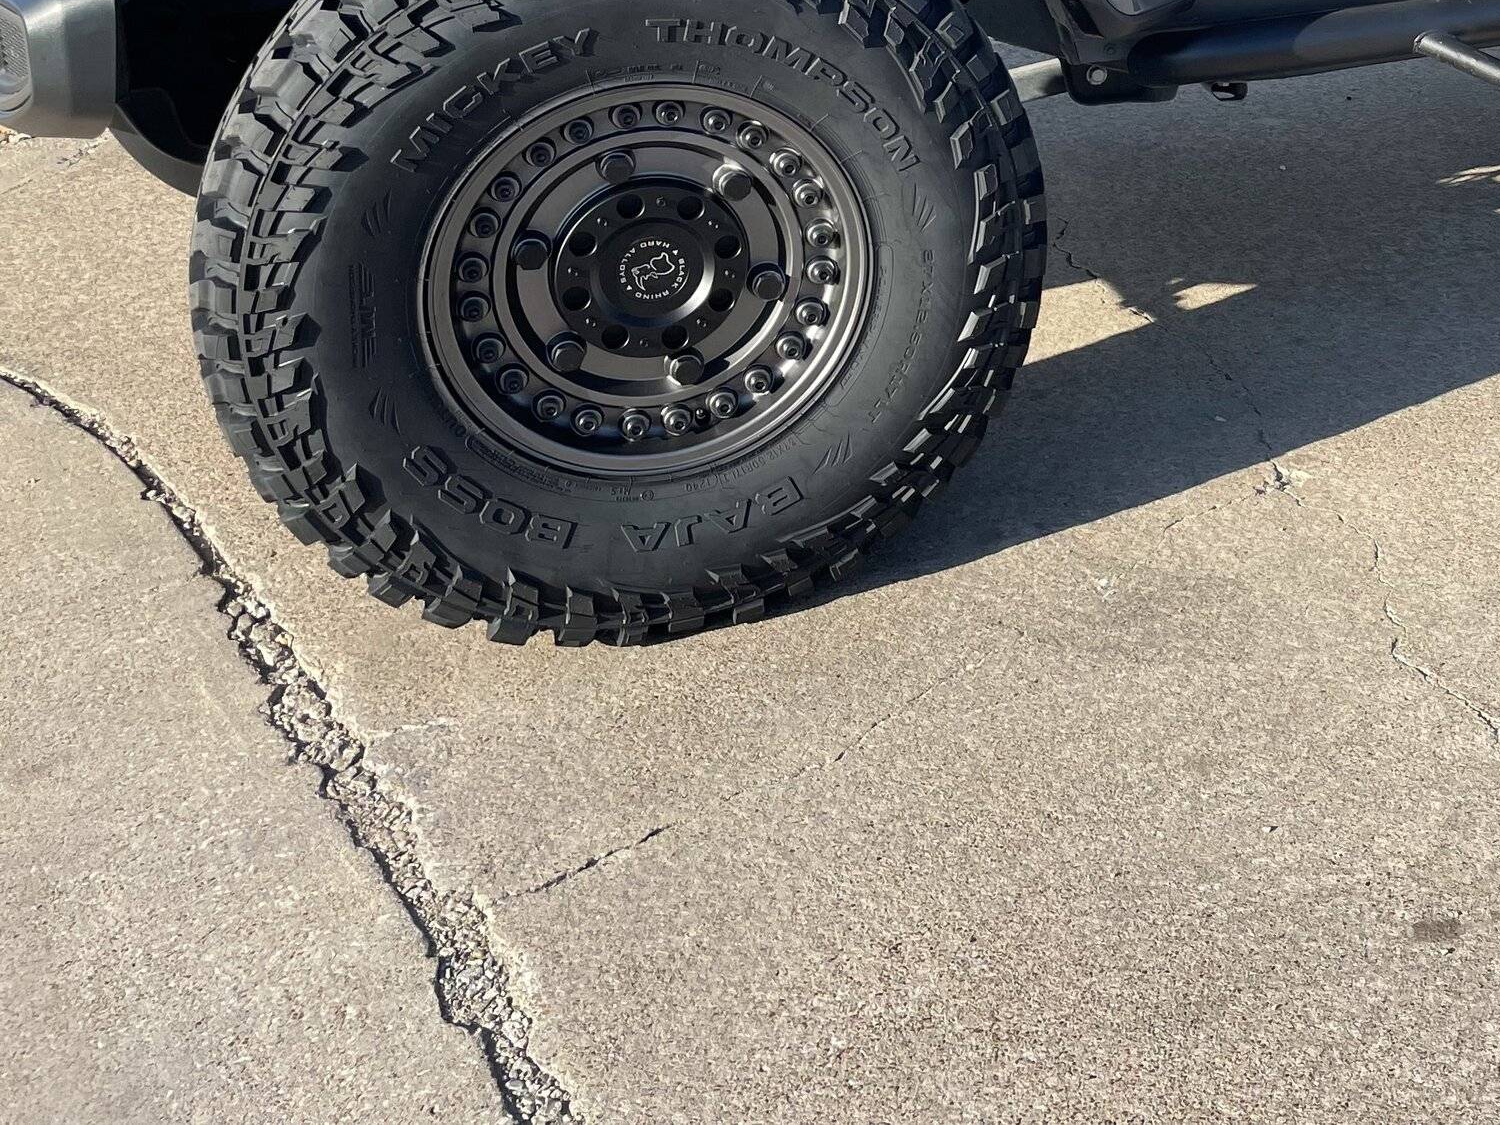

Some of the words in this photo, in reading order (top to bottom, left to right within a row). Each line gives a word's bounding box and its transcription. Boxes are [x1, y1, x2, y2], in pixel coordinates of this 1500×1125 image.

[390, 27, 595, 173] MICKEY
[645, 18, 922, 173] THOMPSON
[640, 240, 670, 248] HARD
[619, 253, 632, 284] ALLOYS
[671, 258, 686, 289] BLACK
[635, 289, 670, 300] RHINO
[402, 445, 579, 550] BOSS
[620, 476, 807, 553] BAJA
